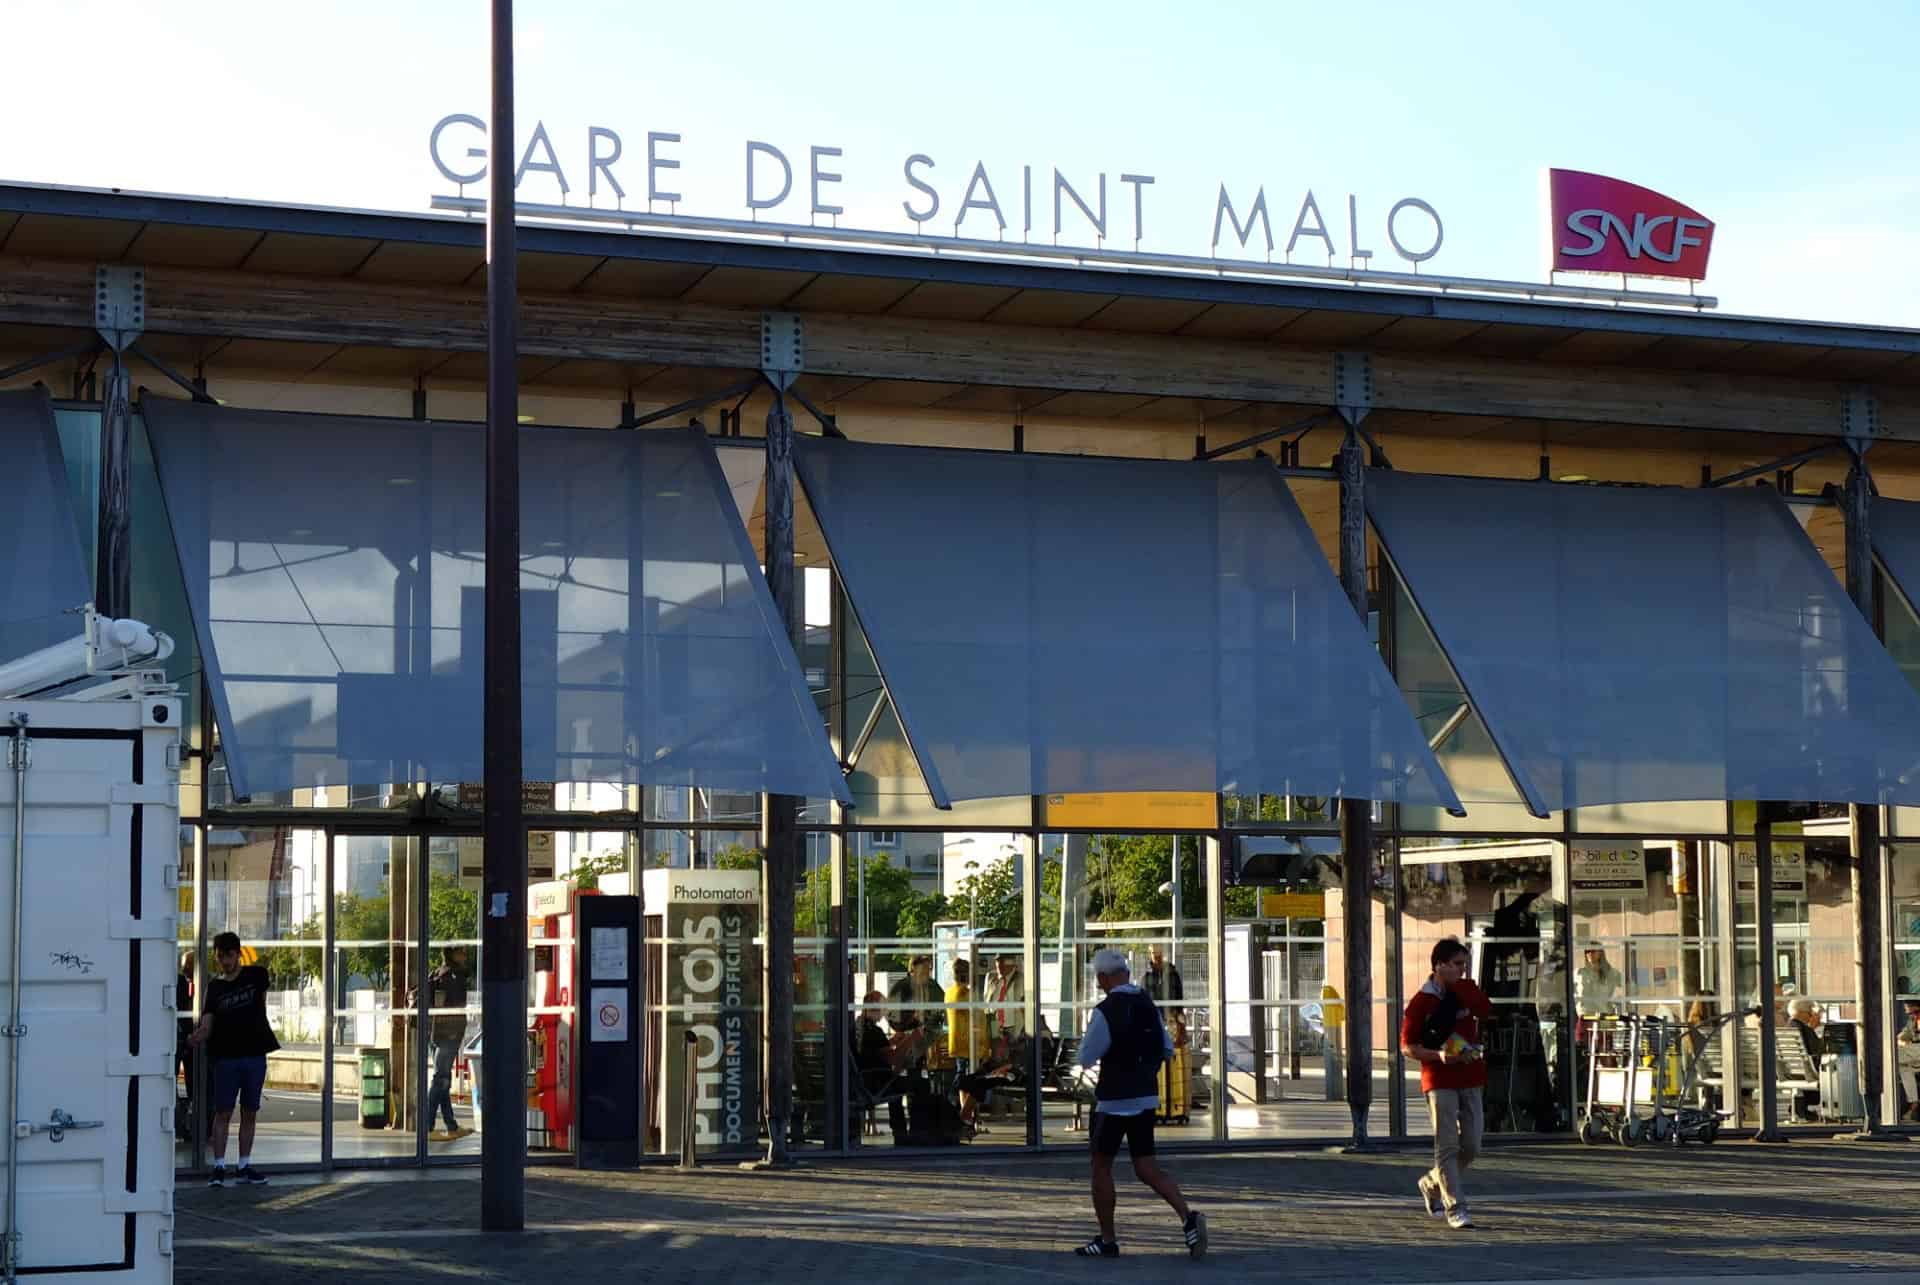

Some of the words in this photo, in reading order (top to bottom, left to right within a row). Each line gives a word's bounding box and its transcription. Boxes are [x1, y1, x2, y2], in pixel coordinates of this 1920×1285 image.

[430, 113, 682, 203] GARE
[745, 140, 843, 215] DE
[902, 154, 1155, 241] SAINT
[1211, 182, 1444, 262] MALO
[1560, 208, 1710, 263] SNCF
[673, 884, 753, 899] Photomaton
[683, 915, 725, 1146] PHOTOS
[726, 1015, 742, 1144] DOCUMENTS
